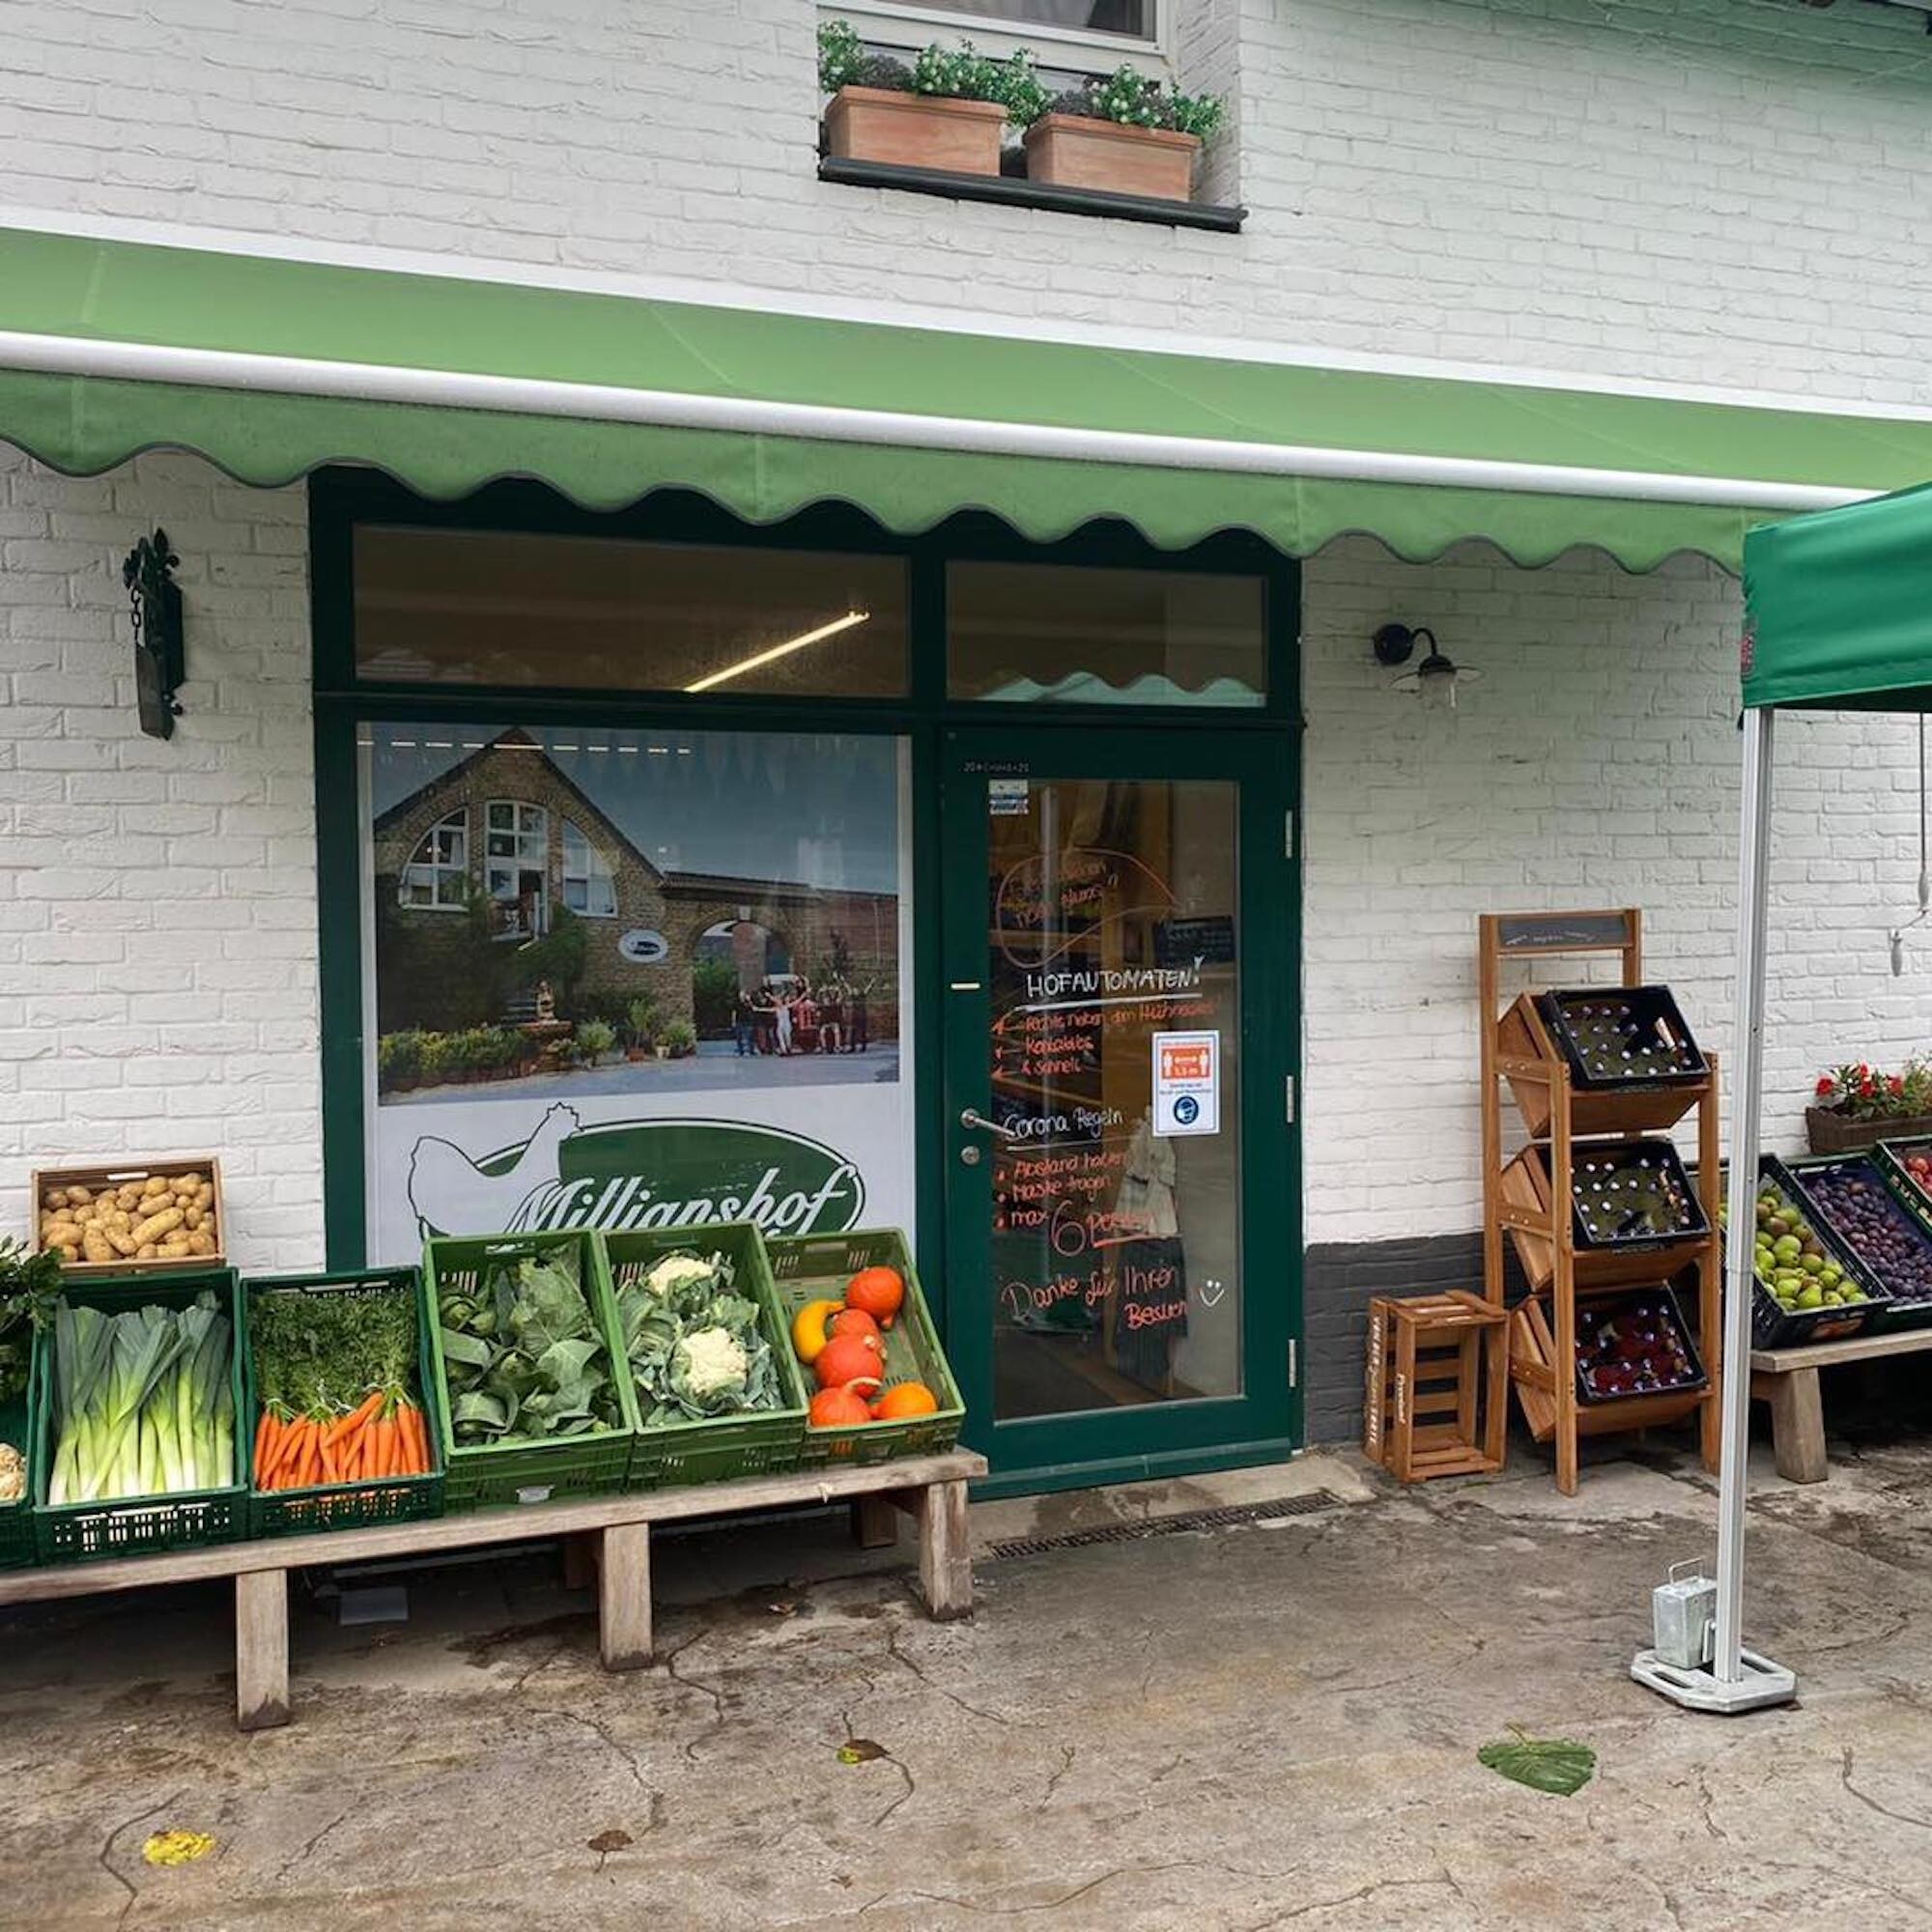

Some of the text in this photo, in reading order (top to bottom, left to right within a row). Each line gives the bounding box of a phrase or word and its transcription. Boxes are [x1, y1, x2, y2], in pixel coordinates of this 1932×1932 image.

[1004, 1106, 1123, 1141] Corona Regeln
[1013, 1154, 1078, 1179] Abstand
[1011, 1175, 1112, 1203] Maske tragen
[1051, 1200, 1087, 1256] 6
[1001, 1273, 1079, 1326] Danke
[1085, 1266, 1117, 1307] für
[1123, 1299, 1189, 1330] Besuch
